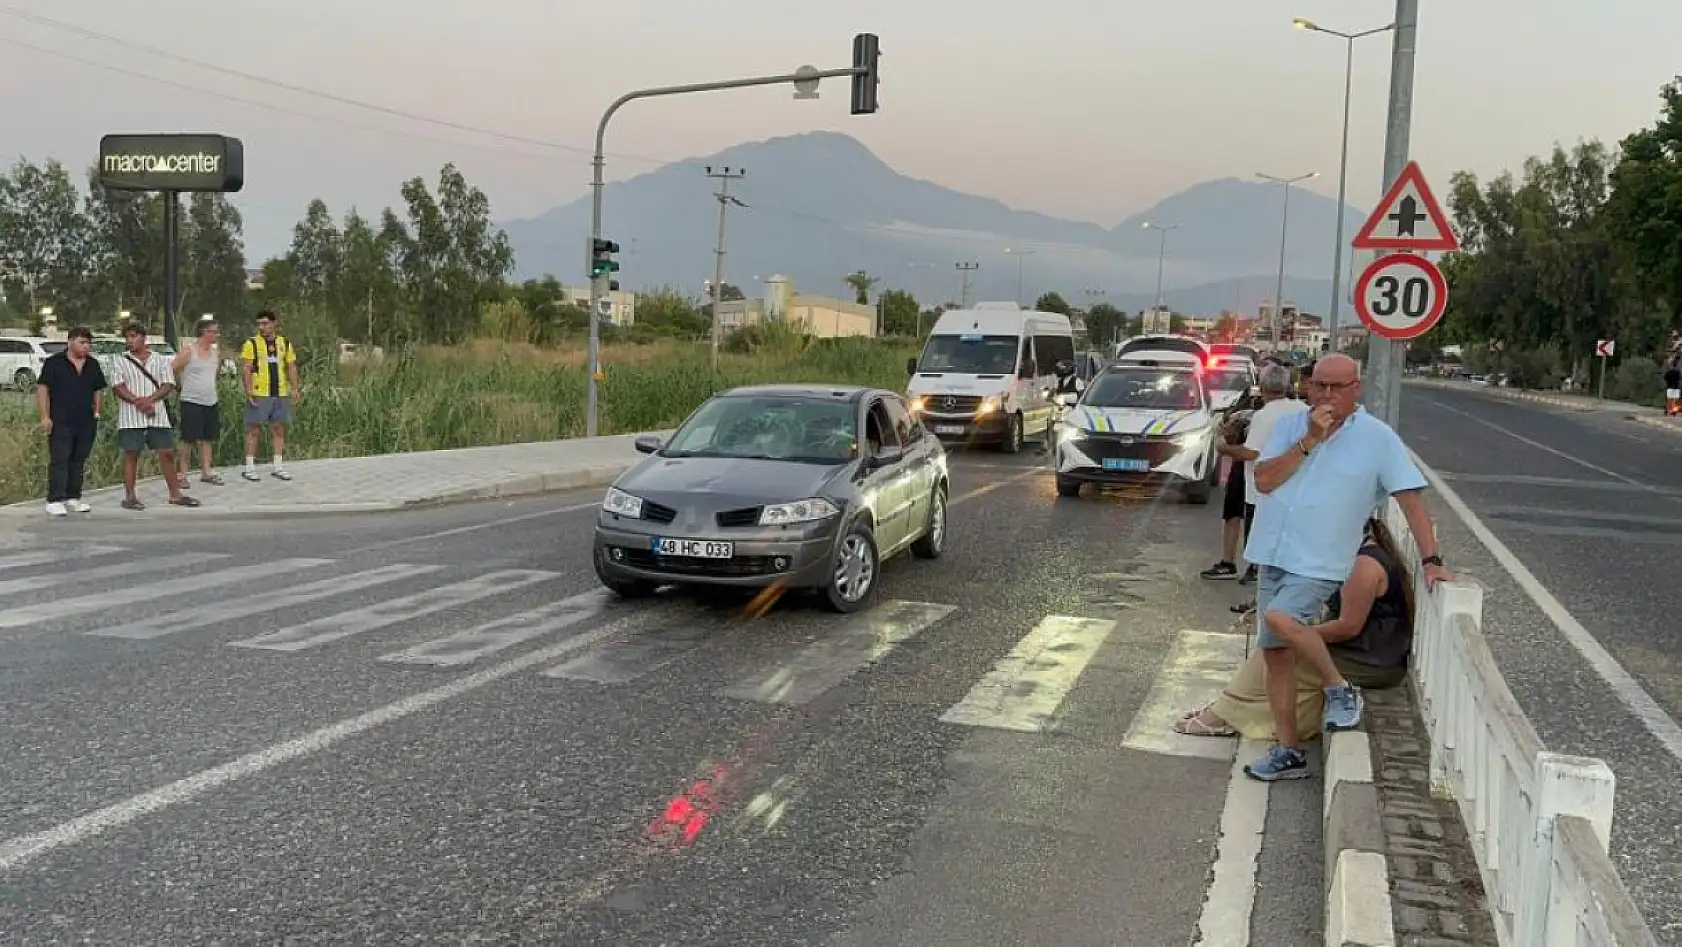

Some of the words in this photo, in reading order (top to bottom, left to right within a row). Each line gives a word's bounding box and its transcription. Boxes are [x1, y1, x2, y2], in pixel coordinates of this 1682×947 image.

[1372, 275, 1429, 317] 30
[662, 540, 675, 553] 48
[681, 541, 700, 555] HC
[705, 542, 730, 557] 033
